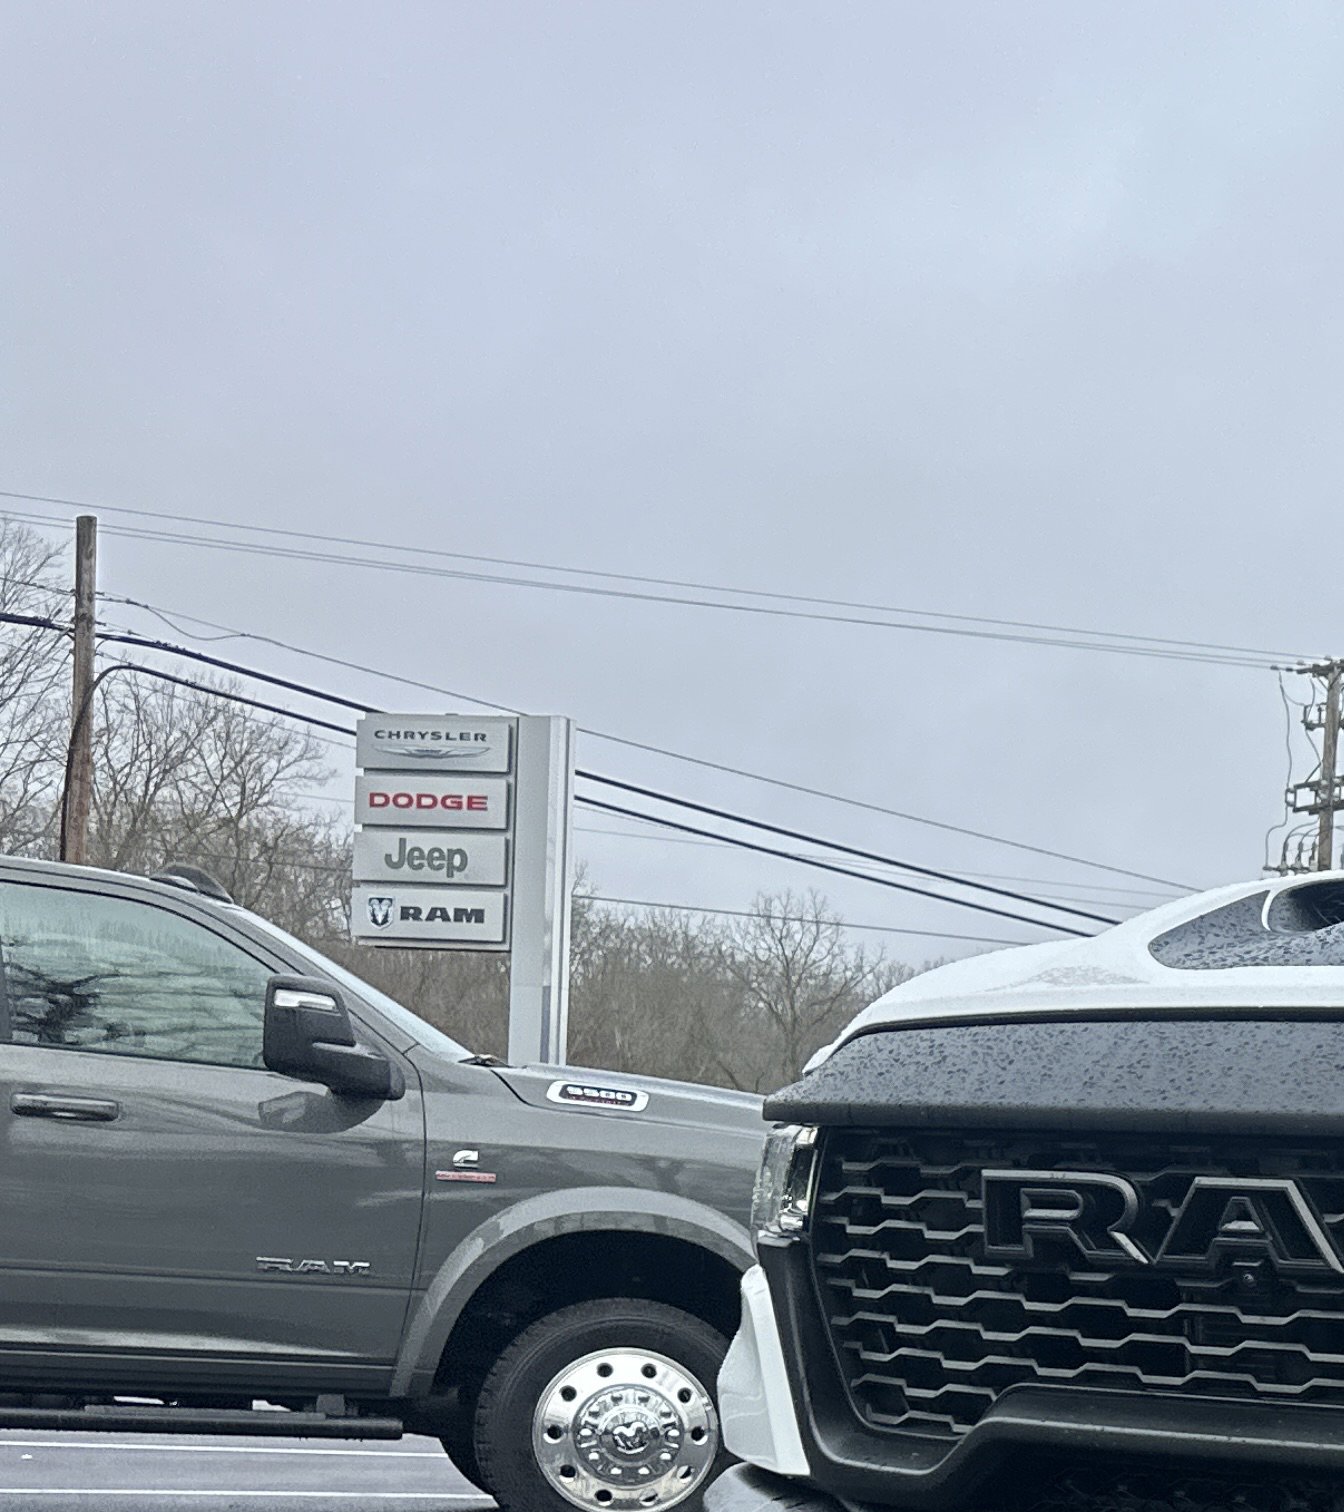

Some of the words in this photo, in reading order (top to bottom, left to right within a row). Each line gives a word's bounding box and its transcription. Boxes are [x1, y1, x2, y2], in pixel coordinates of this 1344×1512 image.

[374, 729, 488, 743] CHRYSLER
[368, 792, 489, 812] DODGE
[384, 837, 469, 879] Jeep
[400, 905, 486, 924] RAM
[256, 1256, 370, 1275] RAM
